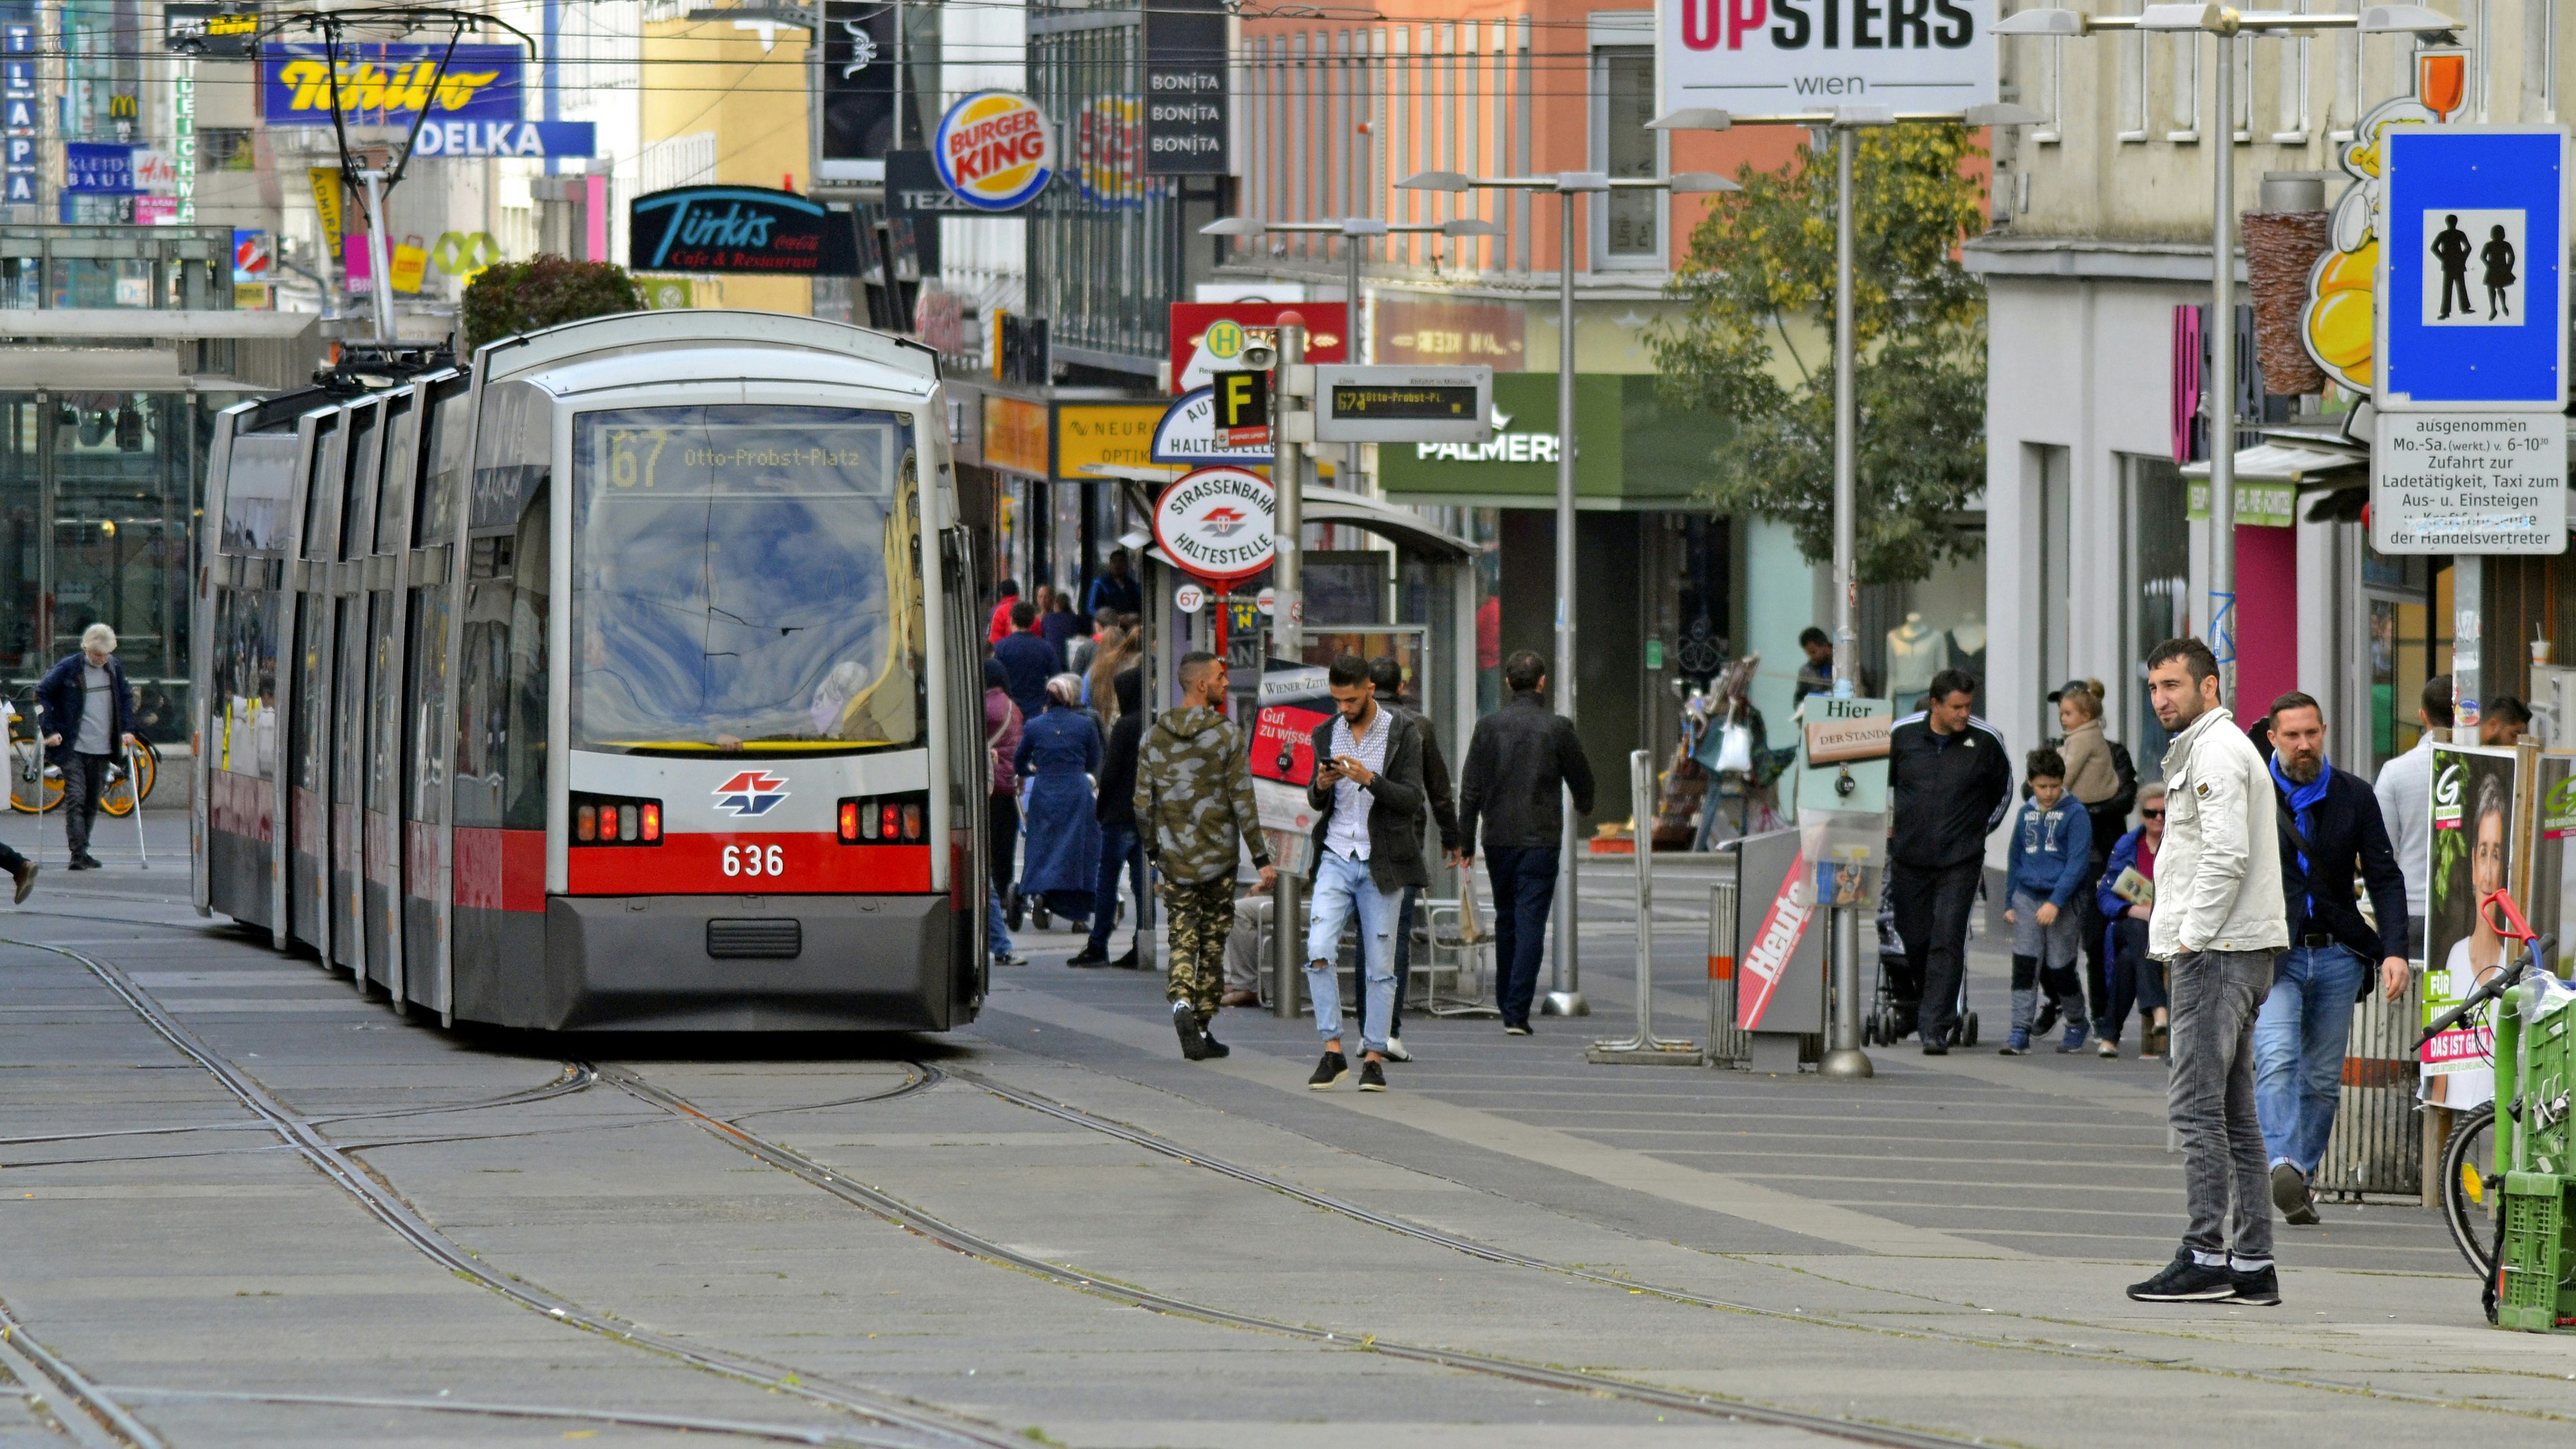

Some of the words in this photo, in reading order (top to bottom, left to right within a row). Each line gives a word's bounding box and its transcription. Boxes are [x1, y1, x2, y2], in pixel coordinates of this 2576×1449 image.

[1681, 0, 1973, 50] UPSTERS
[12, 28, 32, 199] TLAPA
[416, 123, 545, 156] DELKA
[950, 111, 1039, 156] BURGER
[954, 131, 1044, 187] KING
[312, 173, 341, 254] ADMIRAL
[1217, 328, 1235, 352] H
[1228, 376, 1252, 425] F
[2416, 422, 2526, 434] ausgenommen
[2393, 438, 2447, 451] Mo.-Sa.
[2448, 441, 2490, 452] (werkt.)
[611, 430, 667, 488] 67
[685, 449, 860, 466] Otto-Probst-Platz
[2428, 455, 2485, 469] Zufahrt
[2490, 459, 2514, 469] zur
[2383, 474, 2486, 490] Ladetätigkeit,
[2492, 475, 2522, 488] Taxi
[2528, 477, 2559, 488] zum
[2402, 493, 2435, 506] Aus-
[2441, 497, 2453, 506] u.
[2460, 493, 2538, 509] Einsteigen
[1174, 533, 1273, 564] HALTESTELLE
[2391, 531, 2414, 544] der
[1180, 592, 1200, 606] 67
[1238, 613, 1252, 628] N
[1262, 708, 1285, 725] Gut
[1827, 700, 1871, 719] Hier
[1260, 725, 1275, 738] zu
[1820, 734, 1846, 745] DER
[722, 844, 784, 876] 636
[1745, 881, 1804, 981] Heute
[2430, 971, 2450, 996] FÜR
[2430, 1036, 2448, 1058] DAS
[2450, 1034, 2465, 1056] IST
